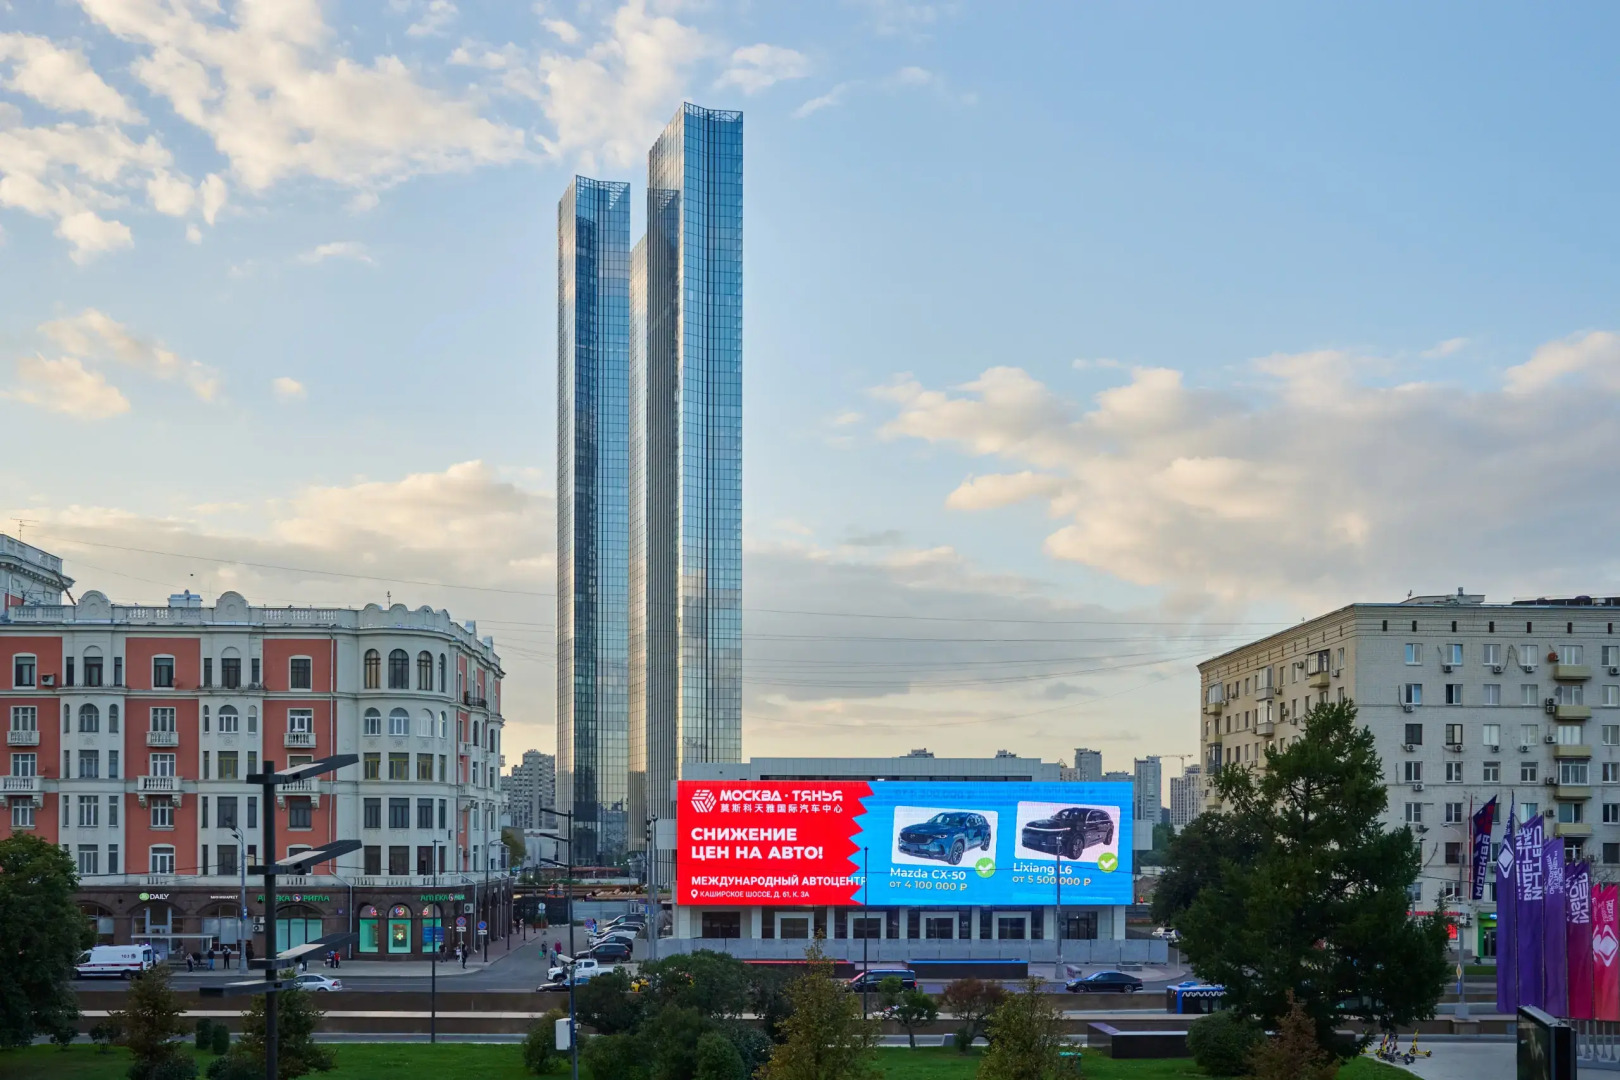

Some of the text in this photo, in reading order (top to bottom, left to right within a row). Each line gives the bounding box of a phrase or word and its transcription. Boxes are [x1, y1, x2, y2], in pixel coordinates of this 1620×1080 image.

[720, 789, 843, 802] МОСКВА ТЯНЬЯ
[720, 803, 843, 813] 莫斯科天雅国际汽车中心
[691, 828, 797, 841] СНИЖЕНИЕ
[691, 846, 823, 861] ЦЕН НА АВТО!
[1013, 863, 1073, 875] Lixiang L6
[1475, 834, 1490, 897] МОСКВА
[890, 867, 966, 880] Mazda CX-50
[691, 874, 799, 886] МЕЖДУНАРОДНЫЙ
[889, 880, 901, 888] от
[915, 880, 932, 888] 100
[935, 881, 956, 890] 000
[1036, 876, 1056, 884] 500
[1059, 876, 1080, 885] 000
